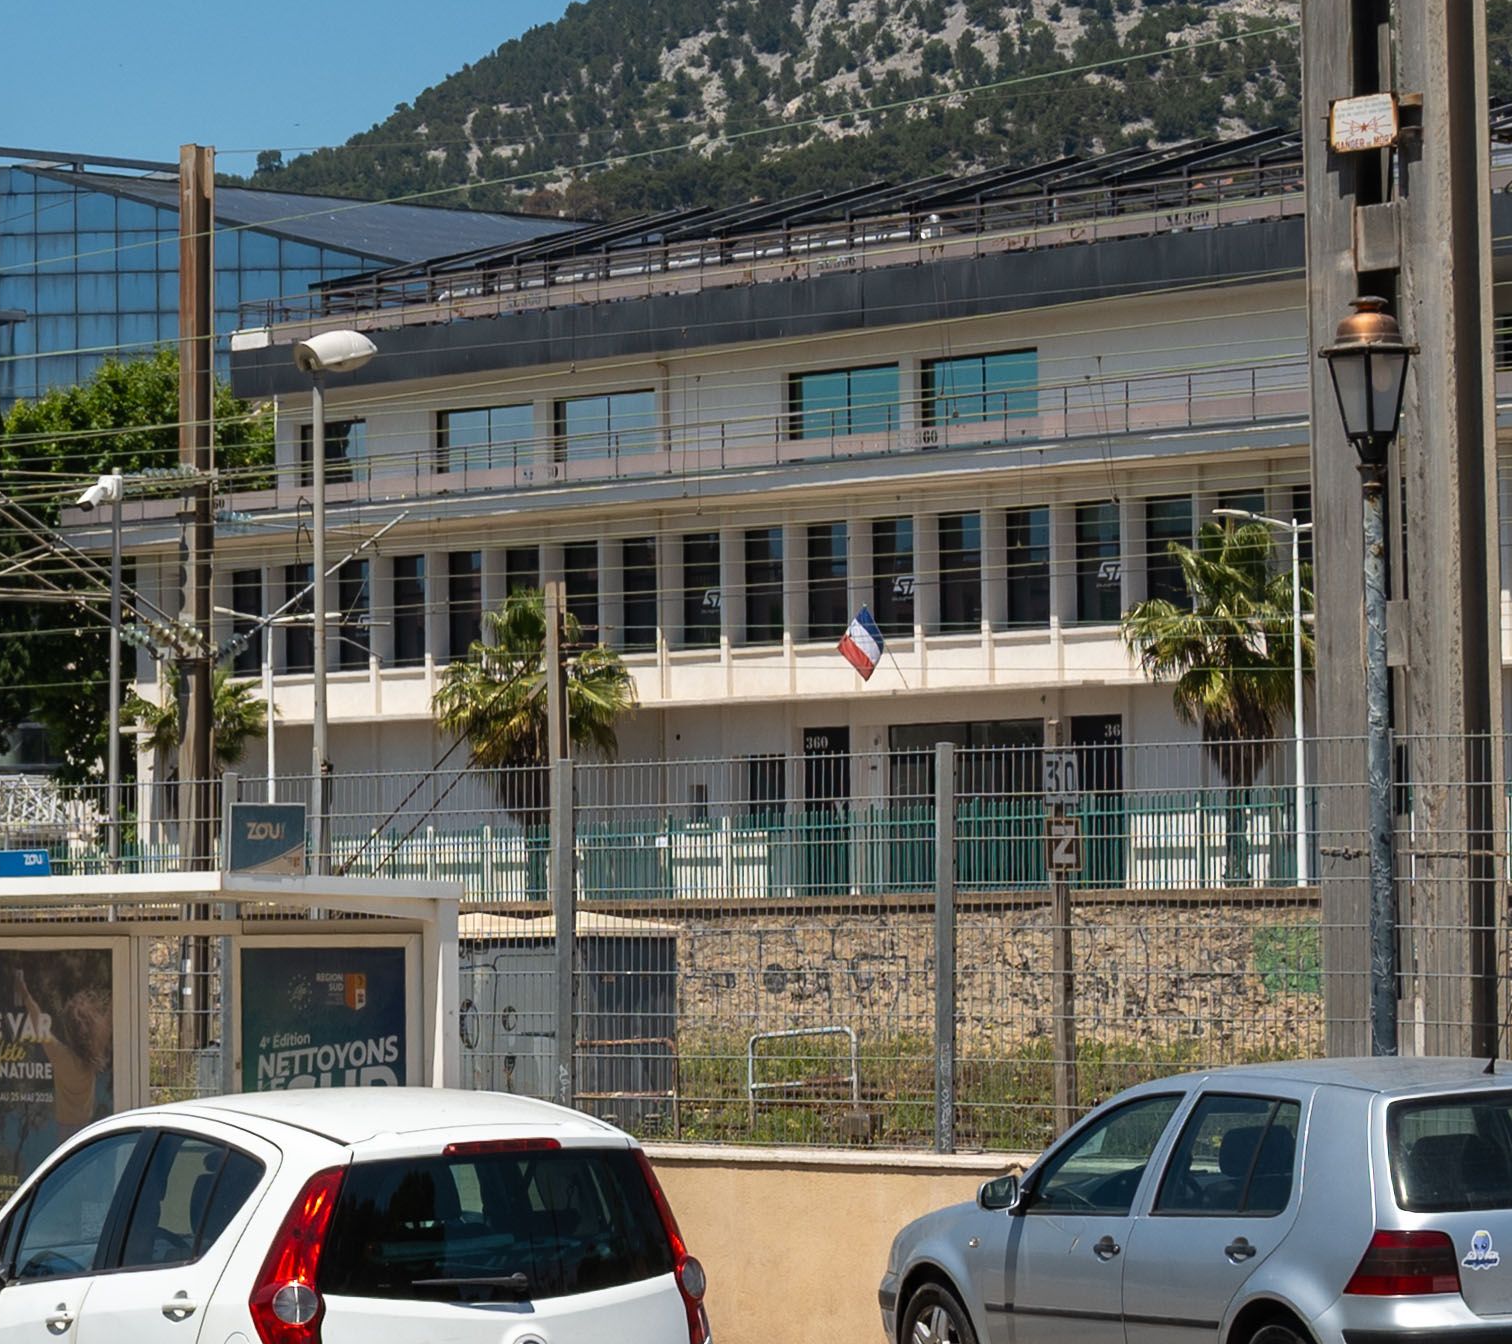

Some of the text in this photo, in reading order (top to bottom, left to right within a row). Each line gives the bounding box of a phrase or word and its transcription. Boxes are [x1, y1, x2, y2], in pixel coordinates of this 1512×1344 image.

[805, 735, 829, 750] 360
[1046, 760, 1075, 796] 30
[1051, 824, 1076, 864] Z
[6, 1012, 53, 1044] VAR
[257, 1035, 399, 1079] NETTOYONS
